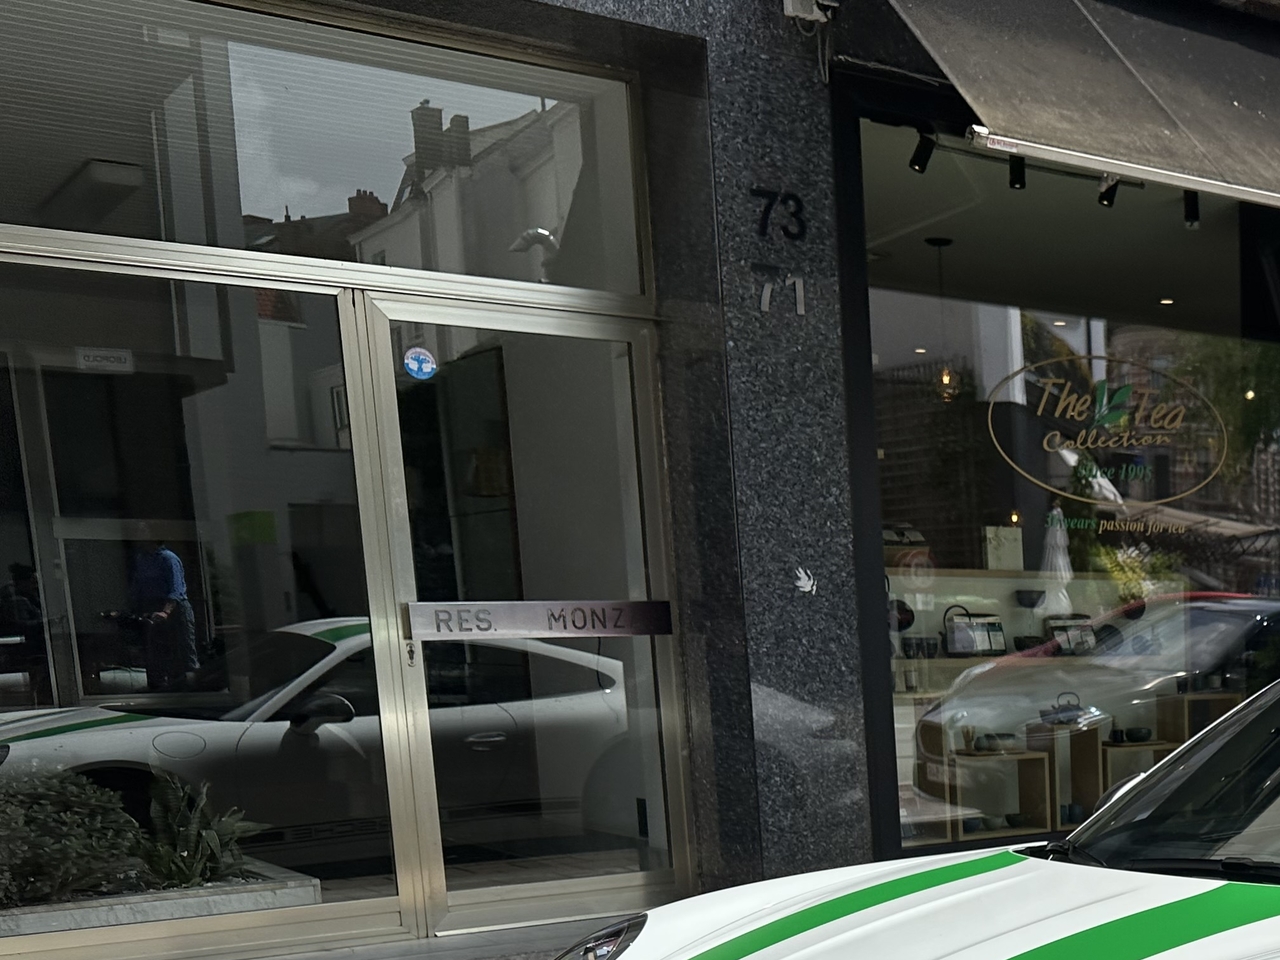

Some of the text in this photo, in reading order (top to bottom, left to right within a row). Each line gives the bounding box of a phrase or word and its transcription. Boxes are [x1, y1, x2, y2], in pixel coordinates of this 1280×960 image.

[750, 188, 806, 240] 73
[750, 263, 805, 315] 71
[1036, 378, 1187, 430] The Tea
[1042, 429, 1171, 452] Collection
[1118, 464, 1154, 481] 1995
[1098, 518, 1145, 534] passion
[433, 606, 640, 633] RES. MONZ
